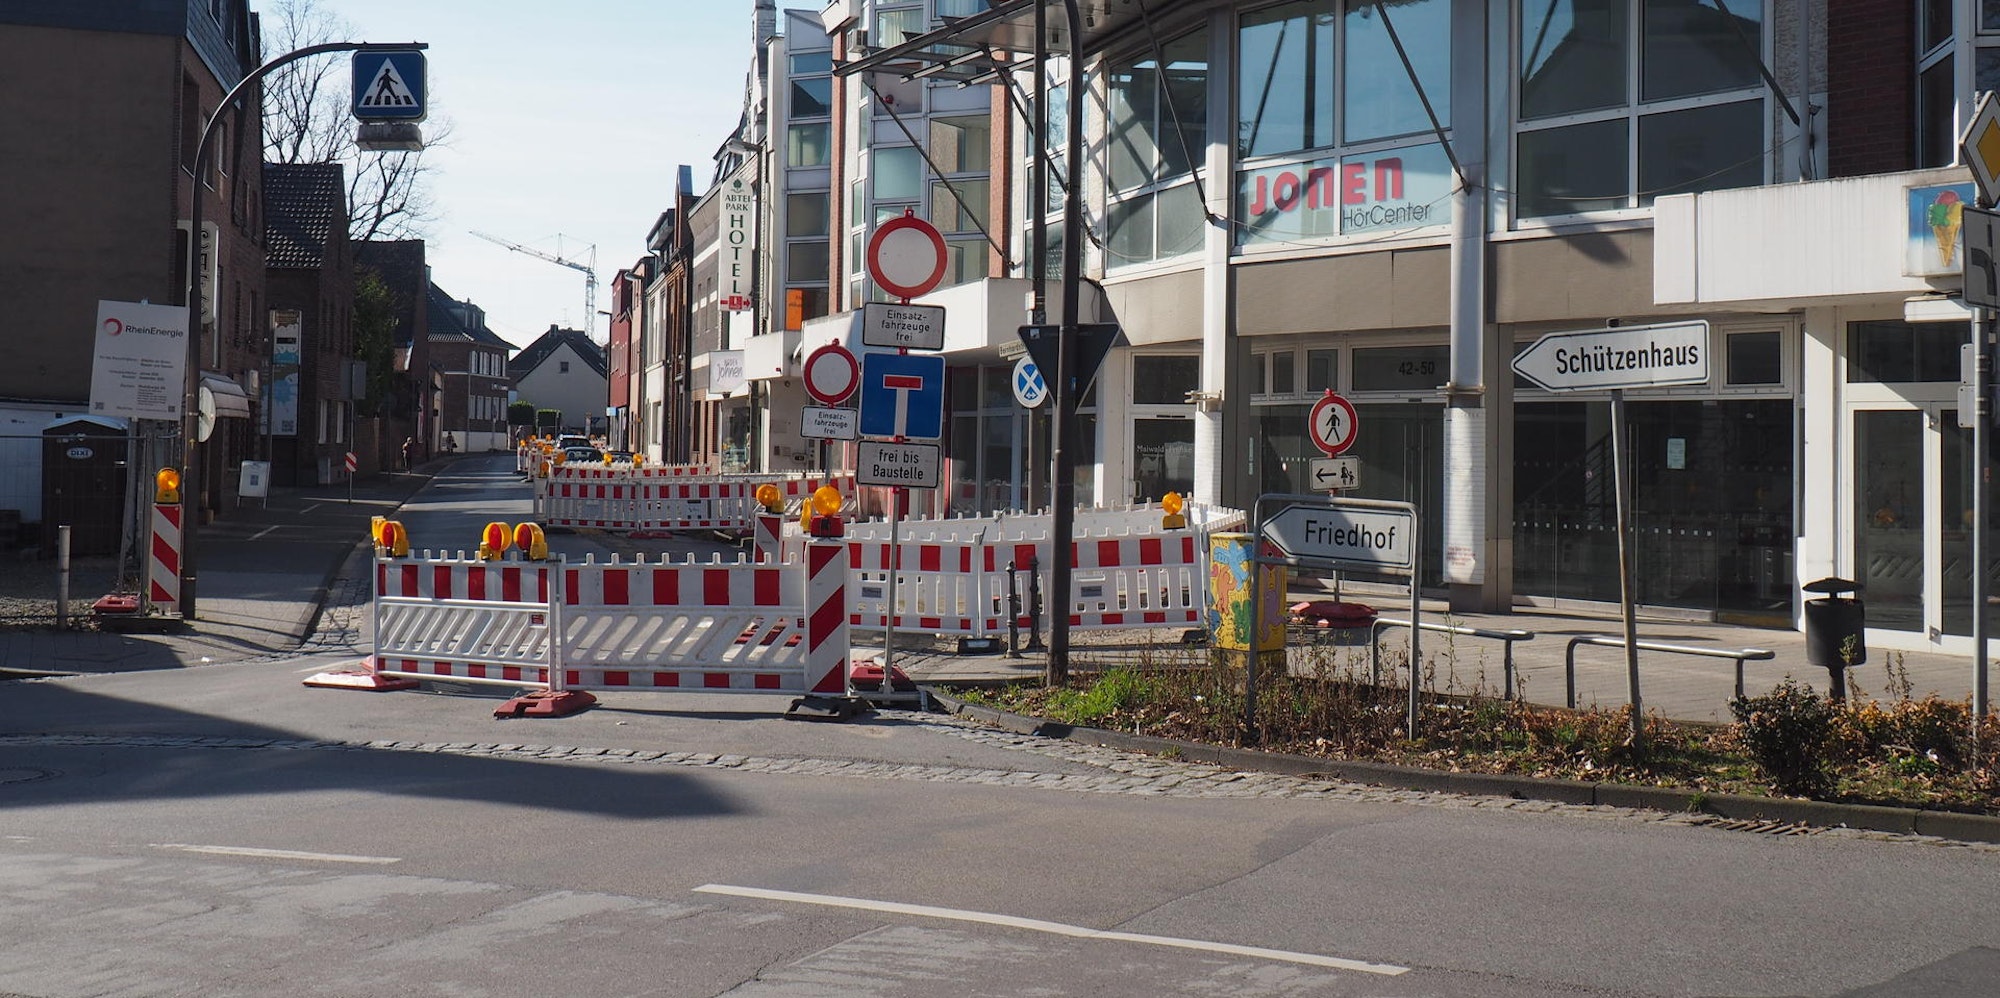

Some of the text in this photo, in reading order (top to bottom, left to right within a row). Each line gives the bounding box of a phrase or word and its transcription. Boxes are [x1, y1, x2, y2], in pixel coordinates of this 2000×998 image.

[725, 194, 751, 203] ABTEI
[725, 203, 748, 211] PARK
[1343, 203, 1431, 228] HörCenter
[728, 214, 745, 294] HOTEL
[887, 309, 927, 320] Einsatz-
[125, 325, 184, 338] RheinEnergie
[881, 319, 930, 333] fahrzeuge
[896, 332, 913, 341] frei
[1556, 341, 1699, 375] Schützenhaus
[1399, 361, 1435, 376] 42-50
[818, 411, 846, 420] Einsatz-
[814, 419, 848, 429] fahrzeuge
[824, 427, 836, 435] frei
[879, 448, 919, 464] frei bis
[873, 464, 924, 480] Baustelle
[1305, 519, 1396, 550] Friedhof
